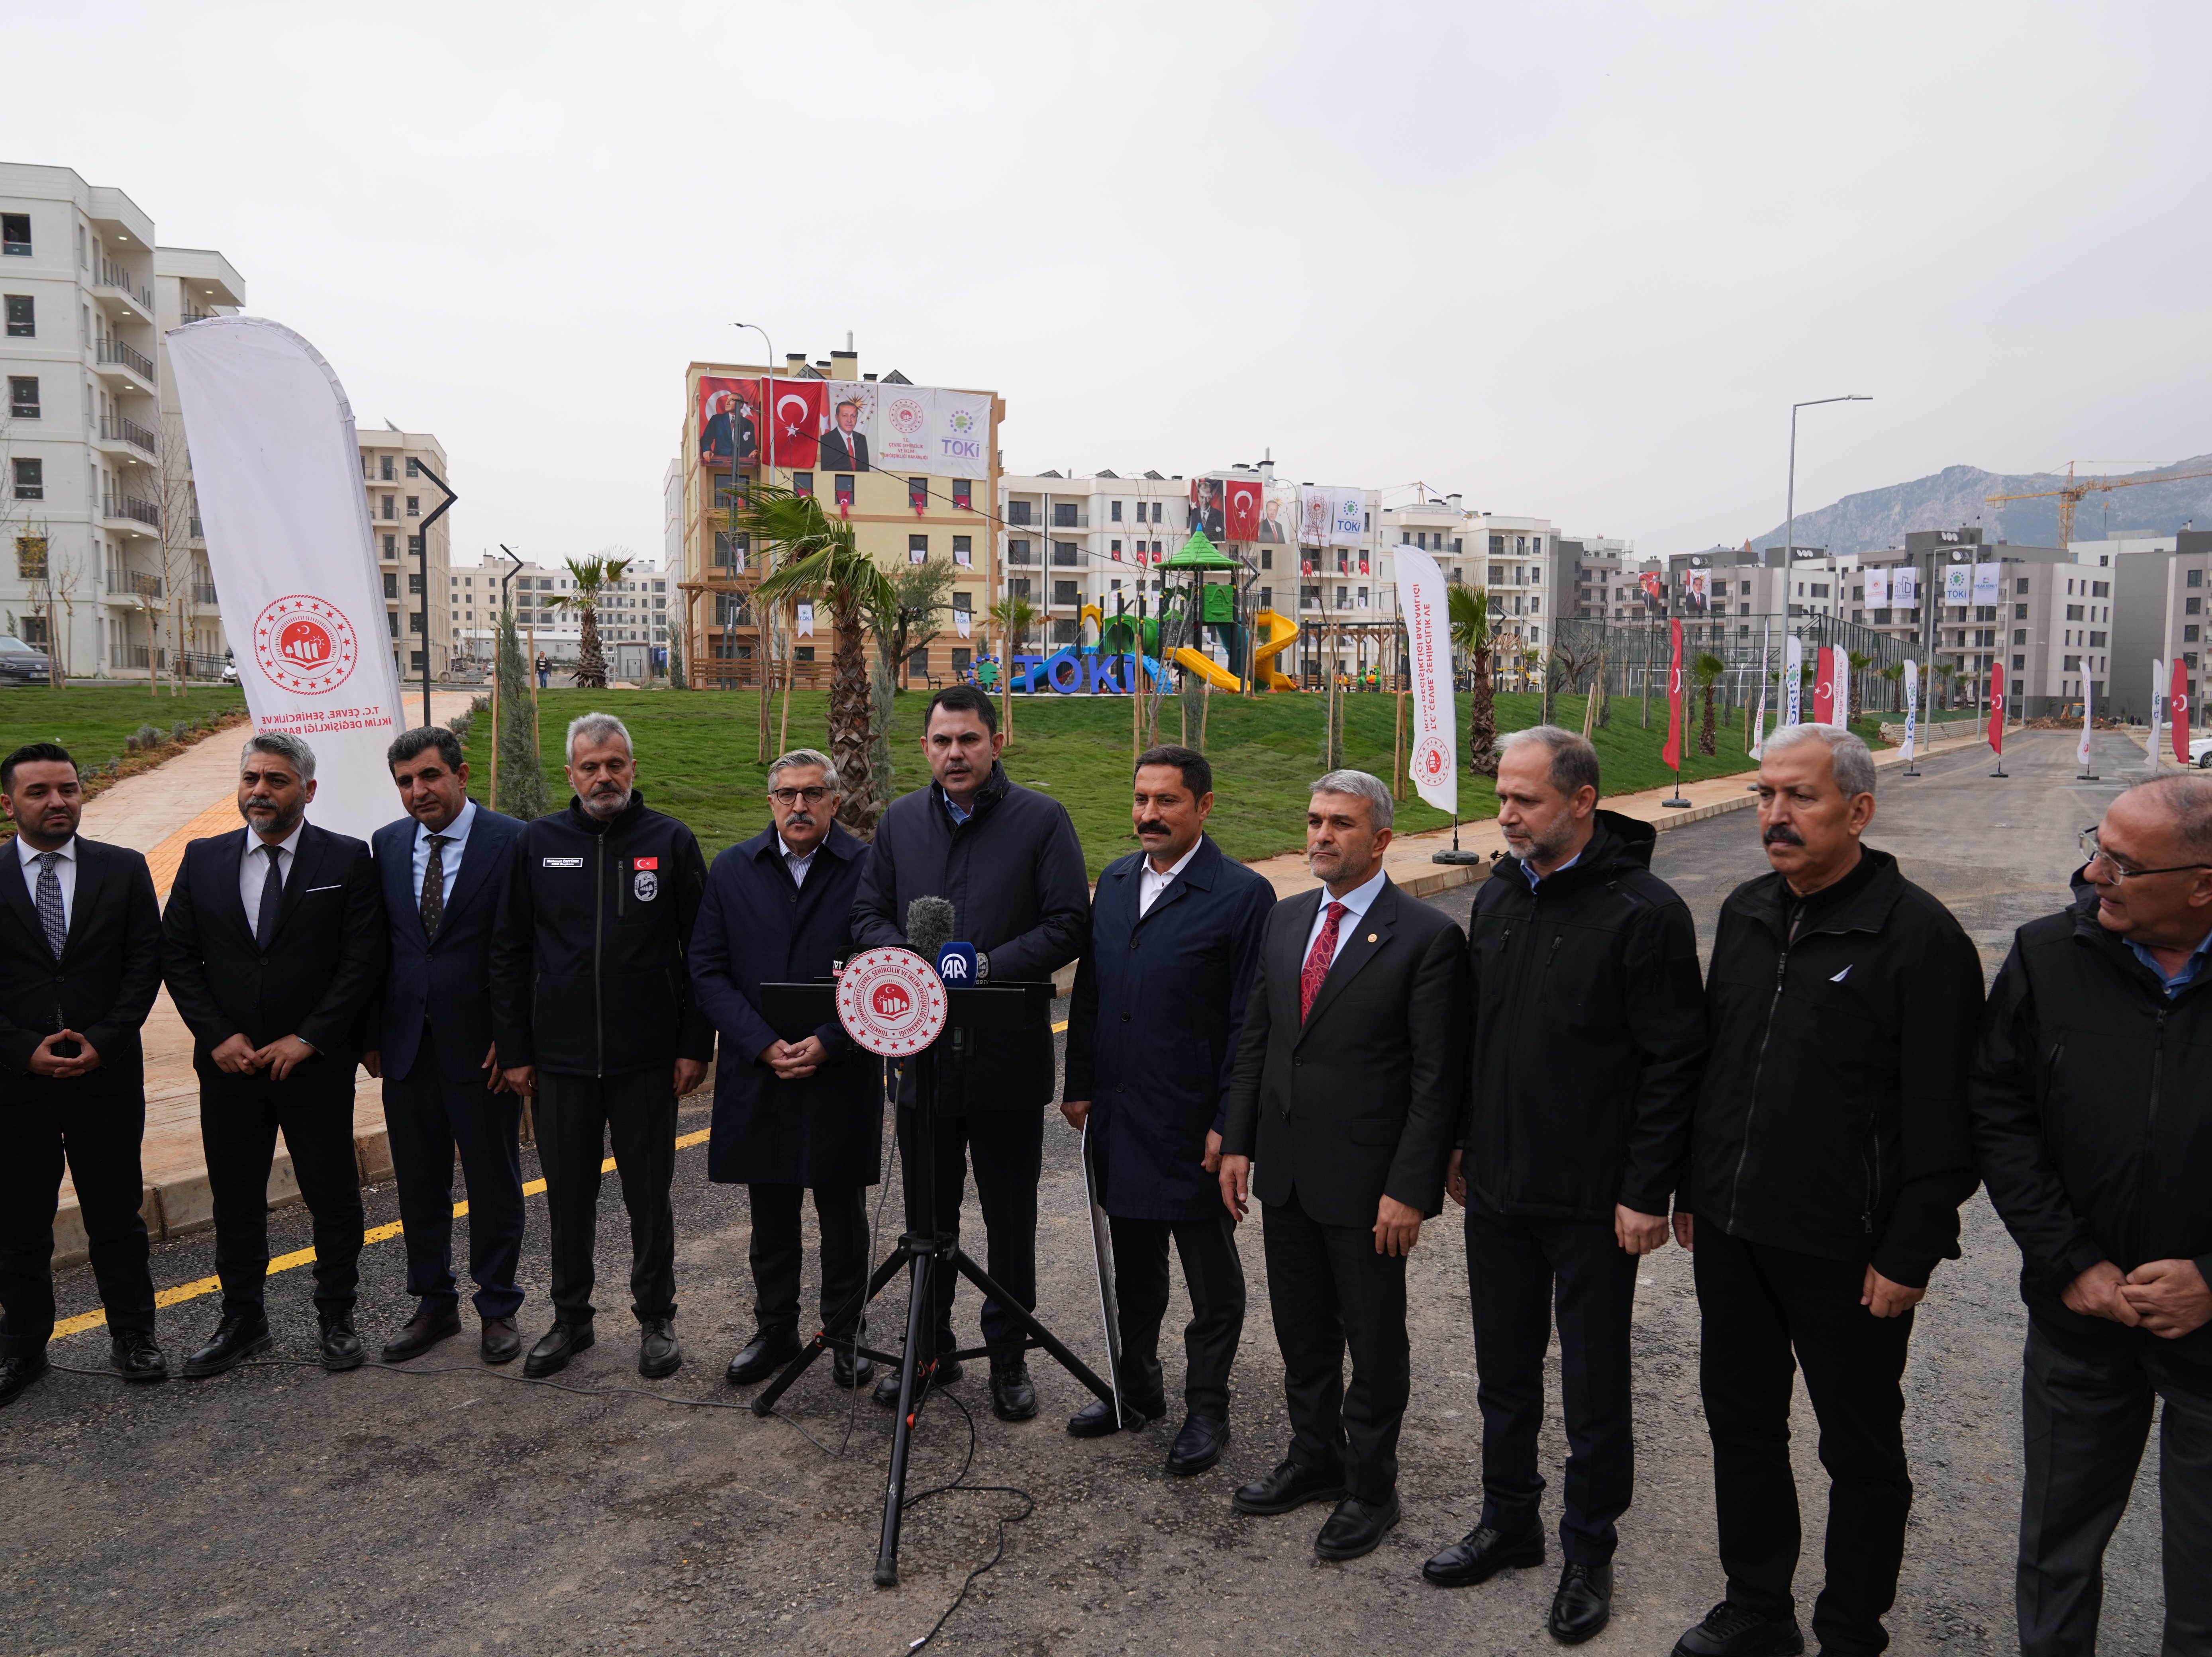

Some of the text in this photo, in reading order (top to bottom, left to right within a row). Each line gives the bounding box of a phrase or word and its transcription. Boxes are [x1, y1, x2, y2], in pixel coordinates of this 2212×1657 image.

[833, 960, 843, 970] TRT
[872, 966, 900, 977] ŞEHİRCİLİK
[942, 960, 967, 978] AA
[859, 974, 873, 989] ÇEVRE,
[907, 973, 921, 988] İKLİM
[855, 988, 869, 1023] CUMHURİYETİ
[918, 987, 928, 1019] DEĞİŞİKLİĞİ
[867, 1022, 888, 1036] TÜRKİYE
[899, 1018, 923, 1037] BAKANLIĞI
